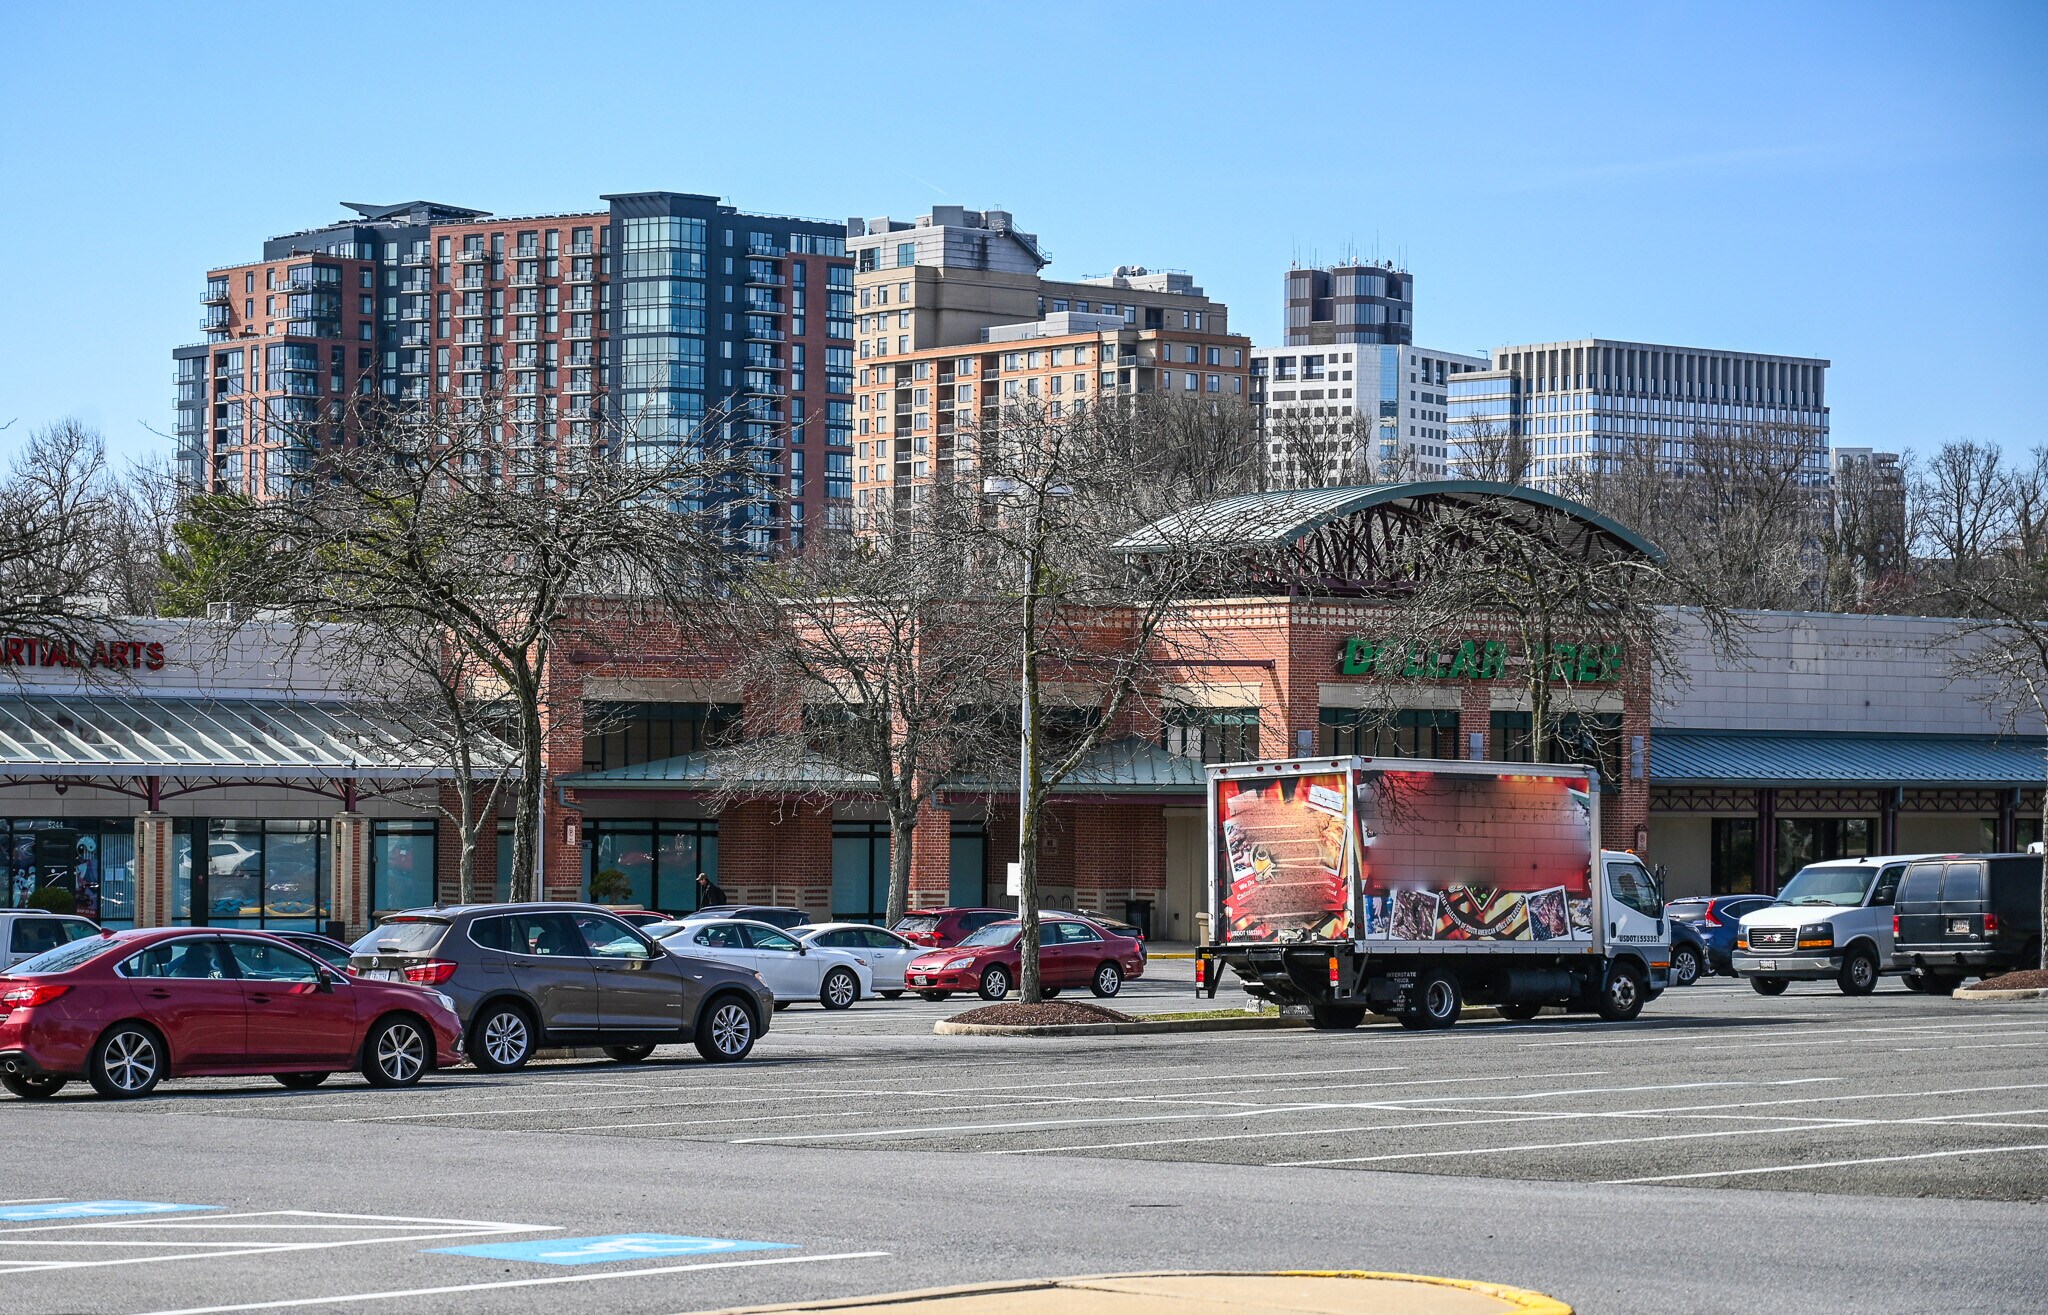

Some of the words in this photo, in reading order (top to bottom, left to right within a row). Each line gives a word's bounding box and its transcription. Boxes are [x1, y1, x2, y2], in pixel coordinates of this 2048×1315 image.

[0, 637, 82, 668] RTIAL
[90, 641, 165, 671] ARTS
[48, 821, 63, 829] 5244
